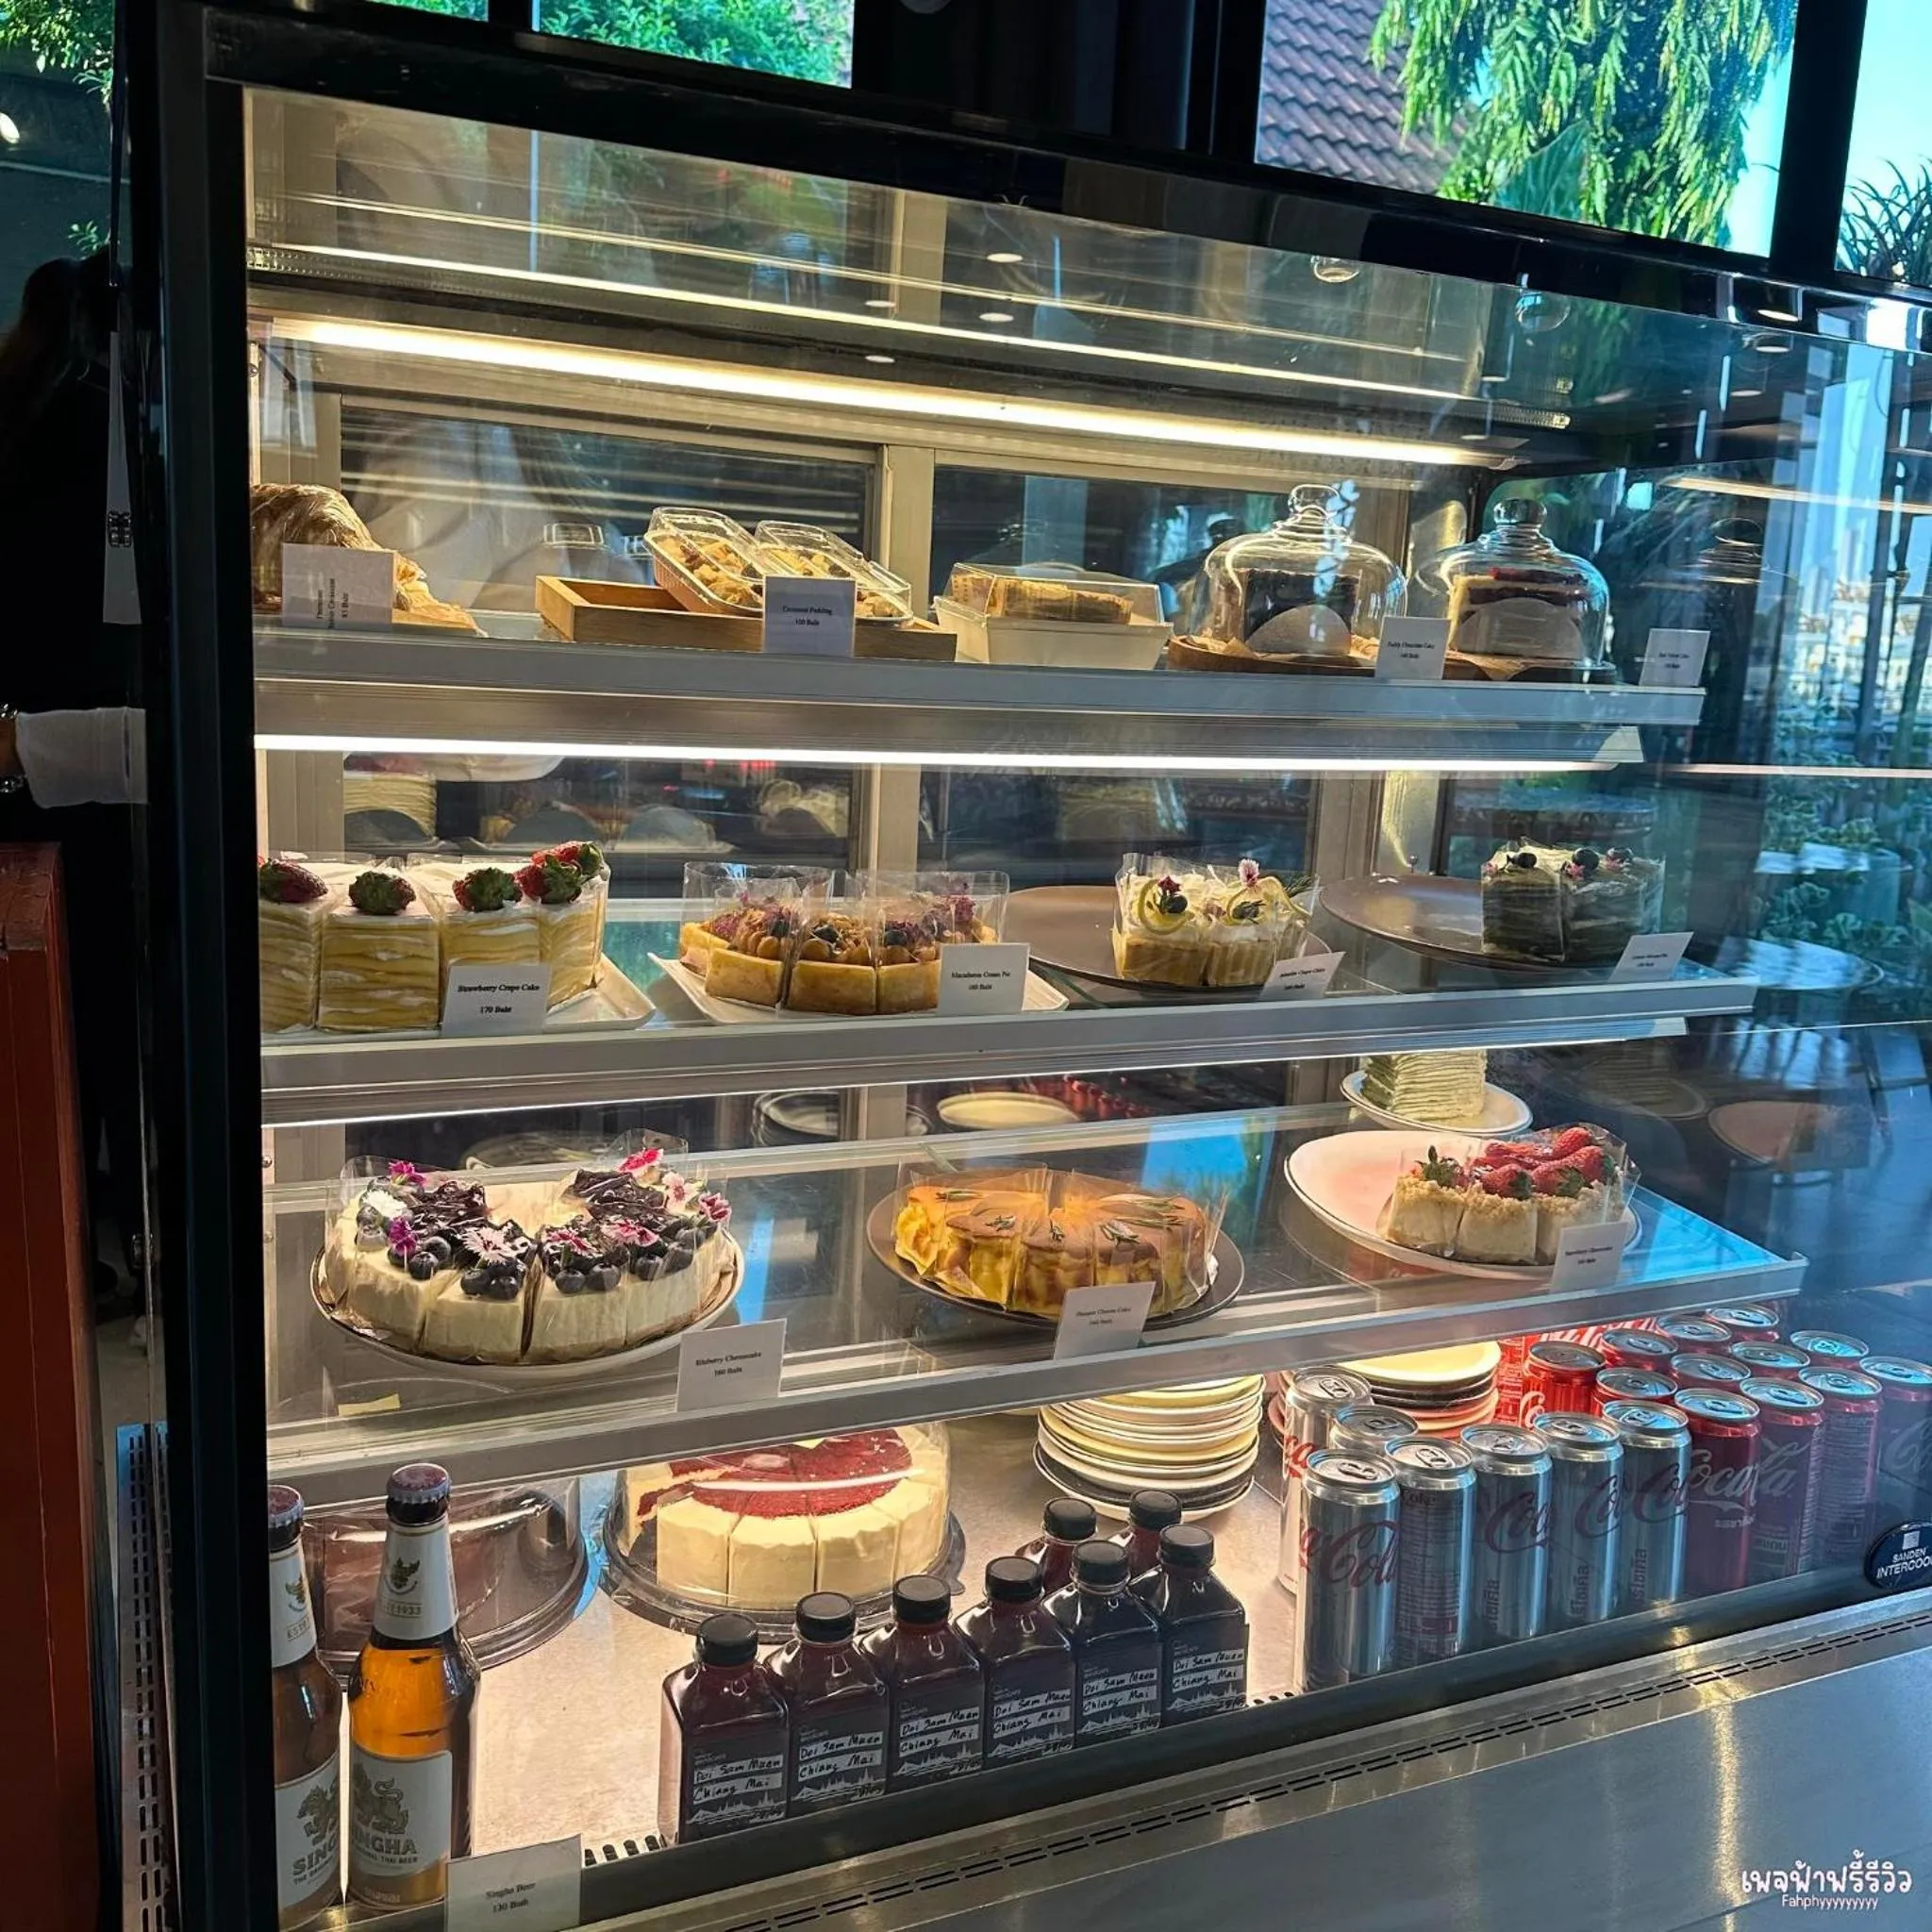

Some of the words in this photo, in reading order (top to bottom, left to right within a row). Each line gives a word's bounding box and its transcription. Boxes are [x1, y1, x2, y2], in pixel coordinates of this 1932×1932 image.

[458, 985, 497, 993] Strawberry
[499, 984, 520, 992] Crepe
[1892, 1547, 1926, 1563] SANDEN
[1173, 1674, 1209, 1689] Chiang
[1218, 1670, 1237, 1679] Mai
[1083, 1698, 1123, 1713] Chiang
[1128, 1690, 1148, 1701] Mai
[993, 1718, 1032, 1732] Chiang
[1039, 1710, 1062, 1722] Mai
[900, 1738, 941, 1753] Chiang
[948, 1728, 974, 1741] Mai
[799, 1763, 840, 1778] Chiang
[848, 1755, 874, 1767] Mai
[693, 1786, 738, 1802] Chiang
[746, 1776, 770, 1790] Mai
[353, 1830, 418, 1856] INGHA
[509, 1899, 529, 1909] Baht
